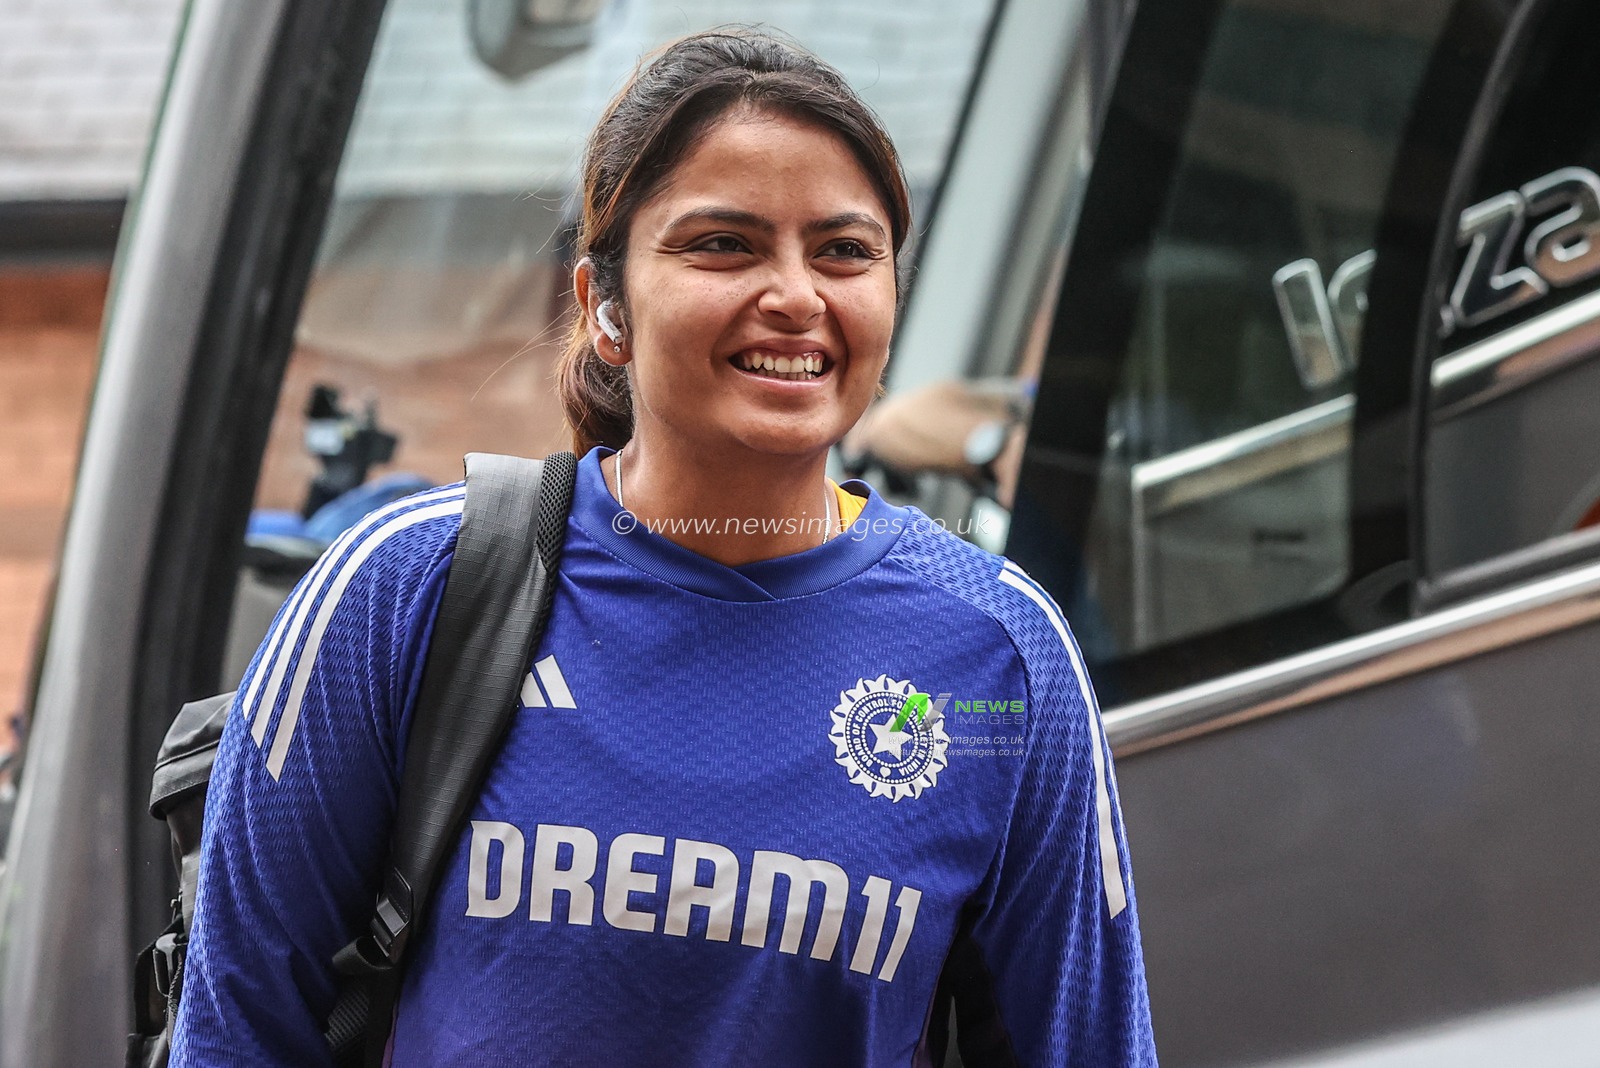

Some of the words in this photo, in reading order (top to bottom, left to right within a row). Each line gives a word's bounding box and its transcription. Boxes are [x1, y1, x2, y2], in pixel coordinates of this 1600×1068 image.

[855, 698, 889, 722] CONTROL
[852, 723, 860, 735] OF
[852, 737, 873, 767] BOARD
[899, 758, 921, 776] INDIA
[465, 820, 922, 983] DREAM11
